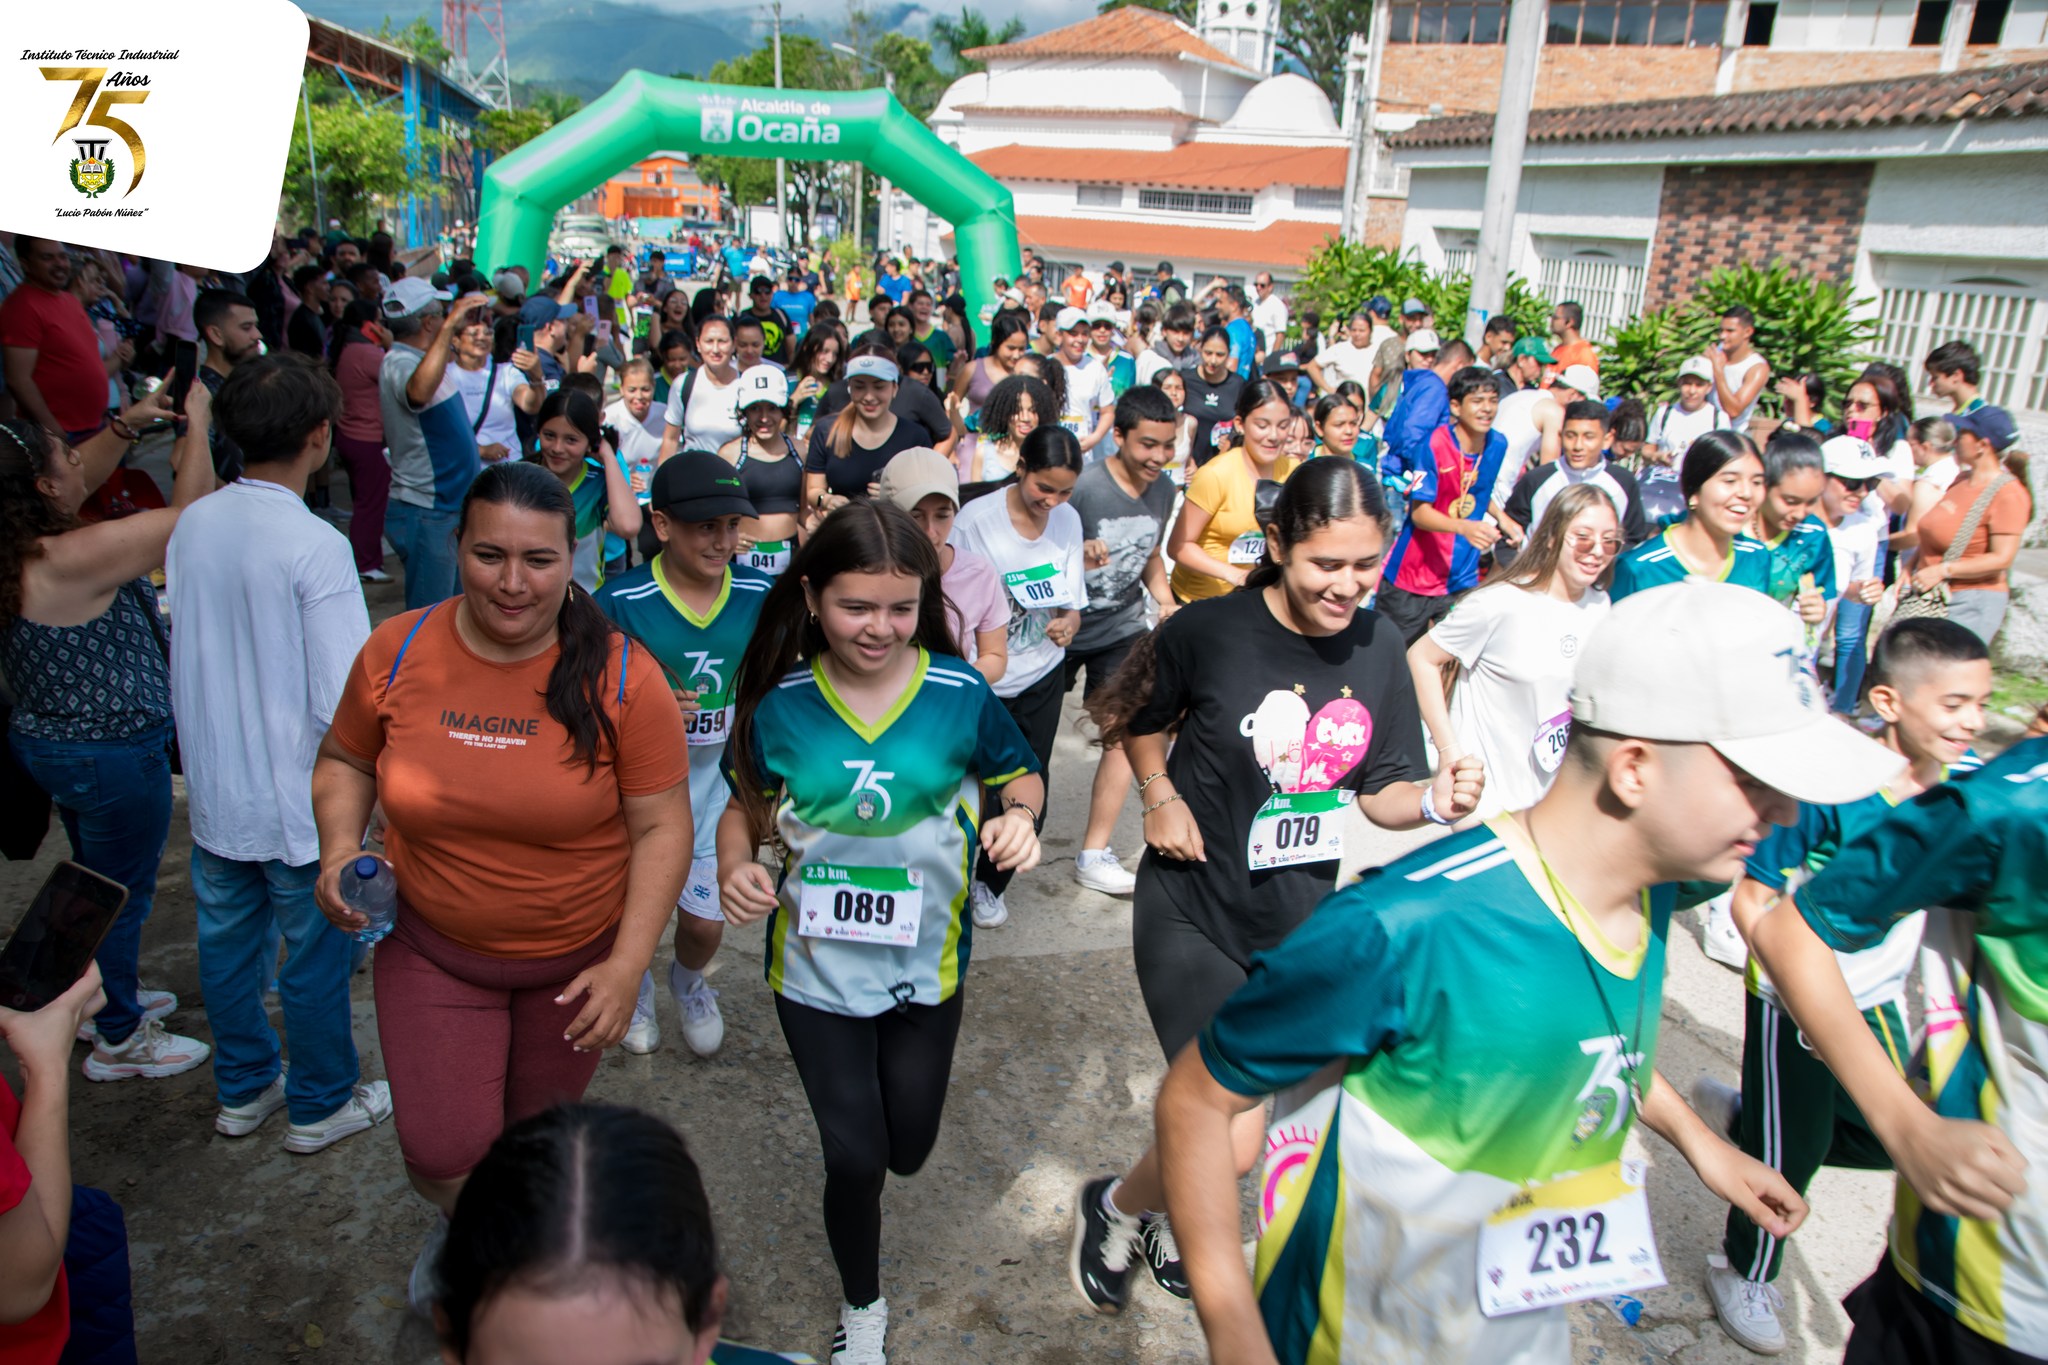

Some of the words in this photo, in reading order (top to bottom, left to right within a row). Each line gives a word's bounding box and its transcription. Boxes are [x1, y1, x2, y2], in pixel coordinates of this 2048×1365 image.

[810, 101, 832, 116] de
[737, 114, 841, 144] Ocaña
[751, 553, 775, 568] 041
[1025, 580, 1055, 601] 078
[683, 650, 725, 695] 75
[439, 709, 540, 736] IMAGINE
[448, 731, 481, 743] THERE'S
[481, 735, 494, 743] NO
[495, 736, 527, 746] HEAVEN
[842, 759, 896, 822] 75
[1275, 815, 1320, 850] 079
[806, 866, 826, 880] 2.5
[828, 866, 851, 881] km.
[833, 889, 895, 926] 089
[1527, 1211, 1612, 1274] 232
